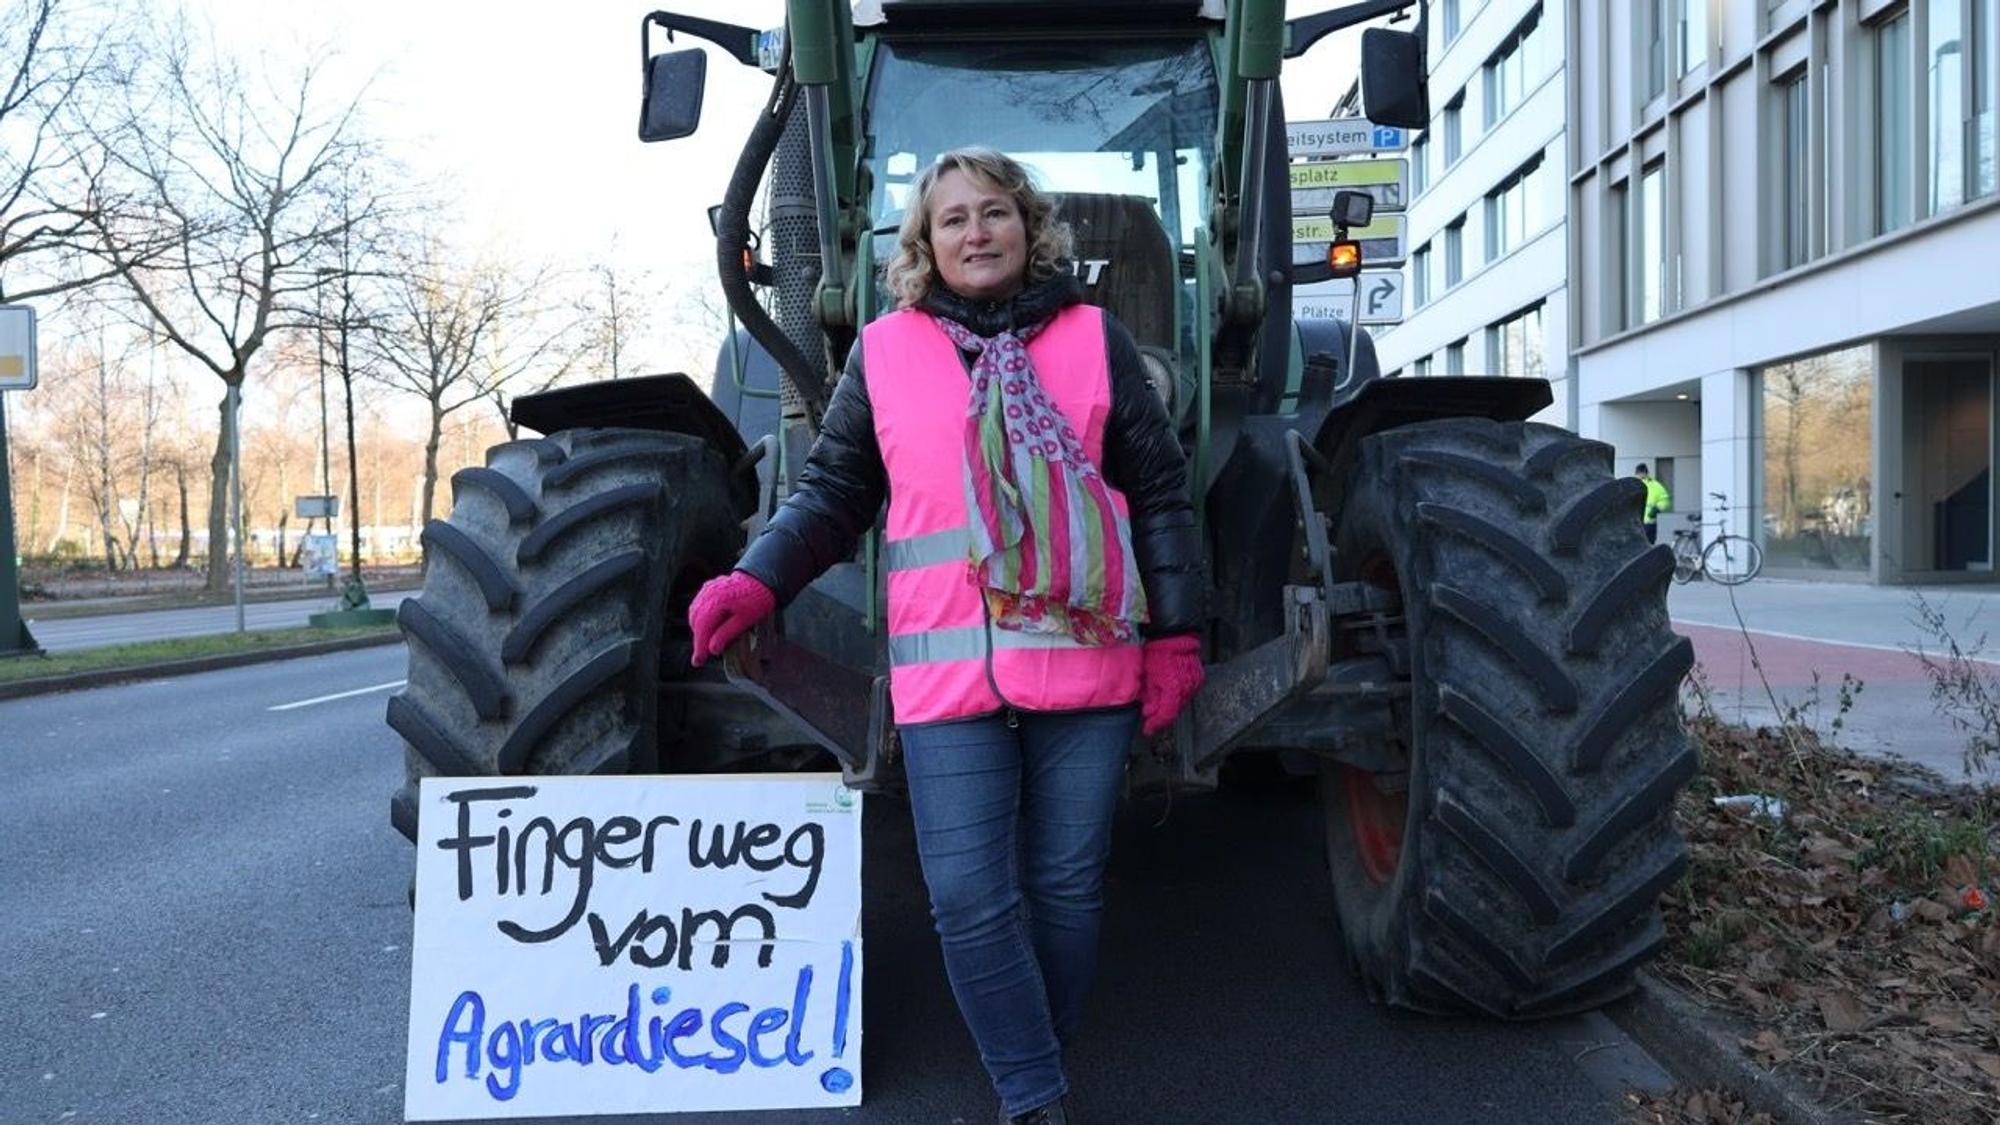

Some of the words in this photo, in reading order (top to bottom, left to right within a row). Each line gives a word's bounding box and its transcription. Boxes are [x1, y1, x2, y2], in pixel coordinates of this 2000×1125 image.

[1292, 225, 1322, 239] str.
[438, 785, 680, 943] Finger
[689, 819, 825, 909] weg
[587, 903, 777, 971] vom
[435, 940, 856, 1102] Agrardiesel!
